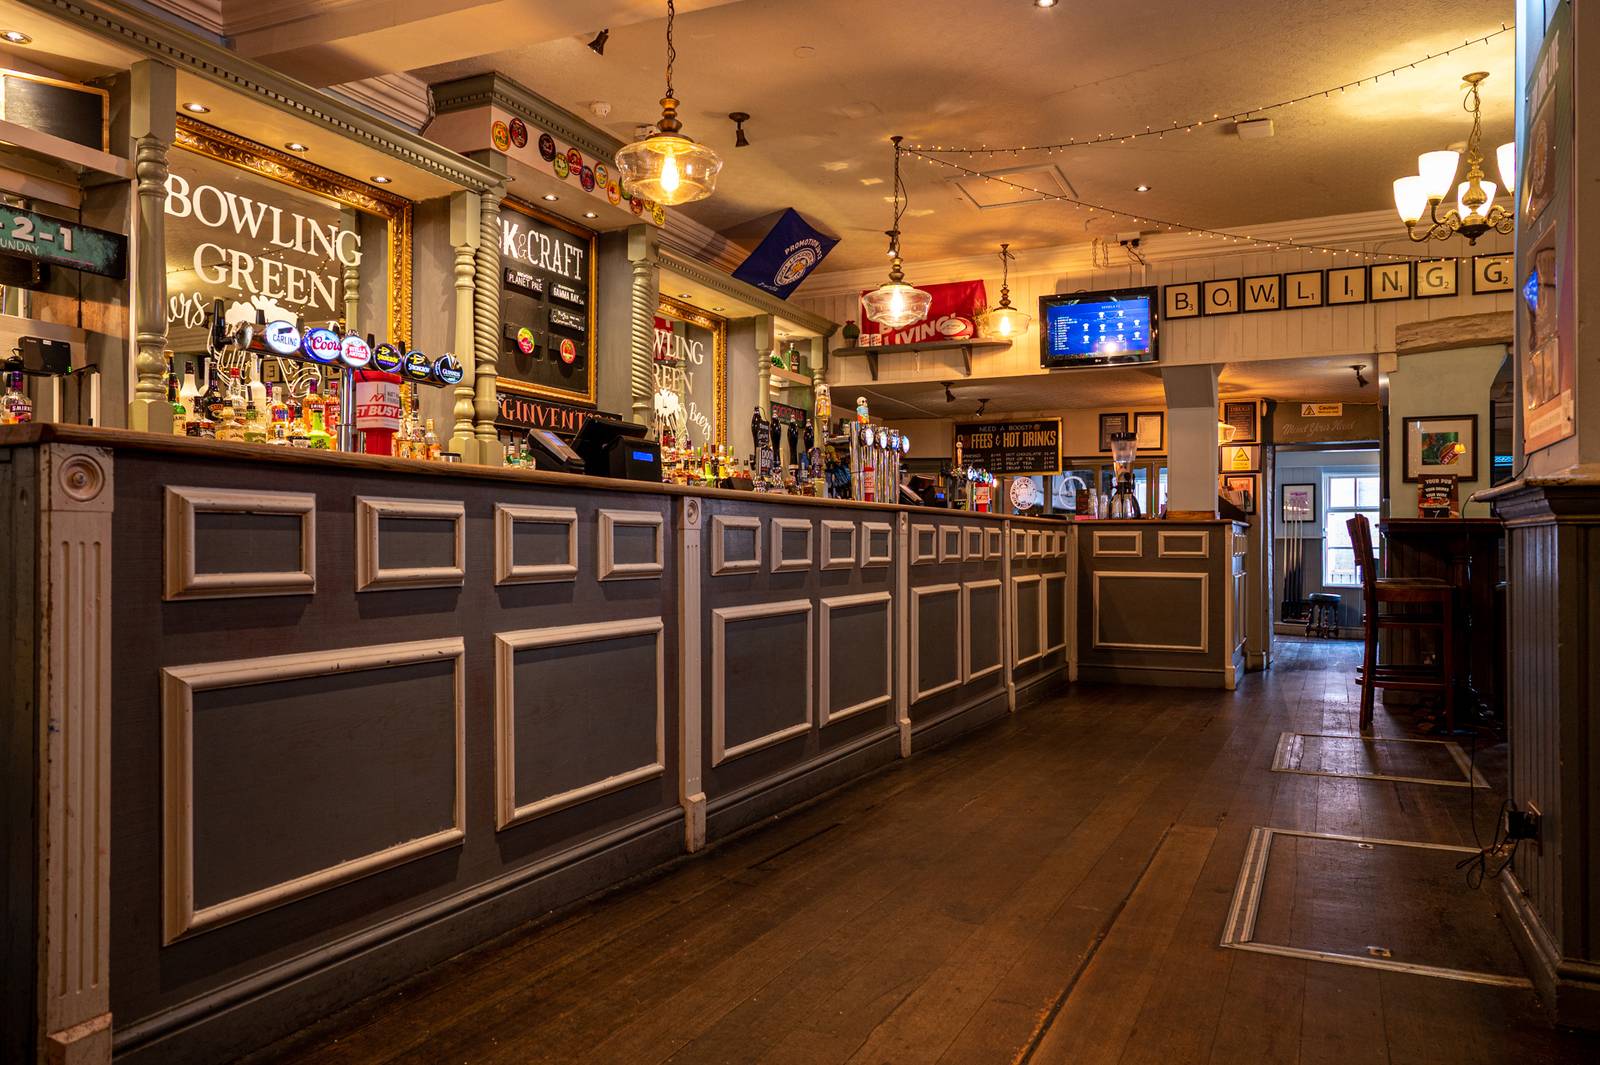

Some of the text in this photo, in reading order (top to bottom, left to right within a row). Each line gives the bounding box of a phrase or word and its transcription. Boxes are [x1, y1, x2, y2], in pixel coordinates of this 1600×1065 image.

[163, 173, 363, 267] BOWLING
[0, 239, 39, 255] UNDAY
[193, 243, 339, 312] GREEN
[272, 333, 298, 347] CARLING
[309, 335, 343, 352] Coors
[652, 328, 704, 365] WLING
[652, 363, 694, 395] REEN
[356, 405, 397, 417] ET BUSY
[688, 402, 713, 440] Beers
[1003, 431, 1020, 448] HOT
[1022, 430, 1056, 447] DRINKS
